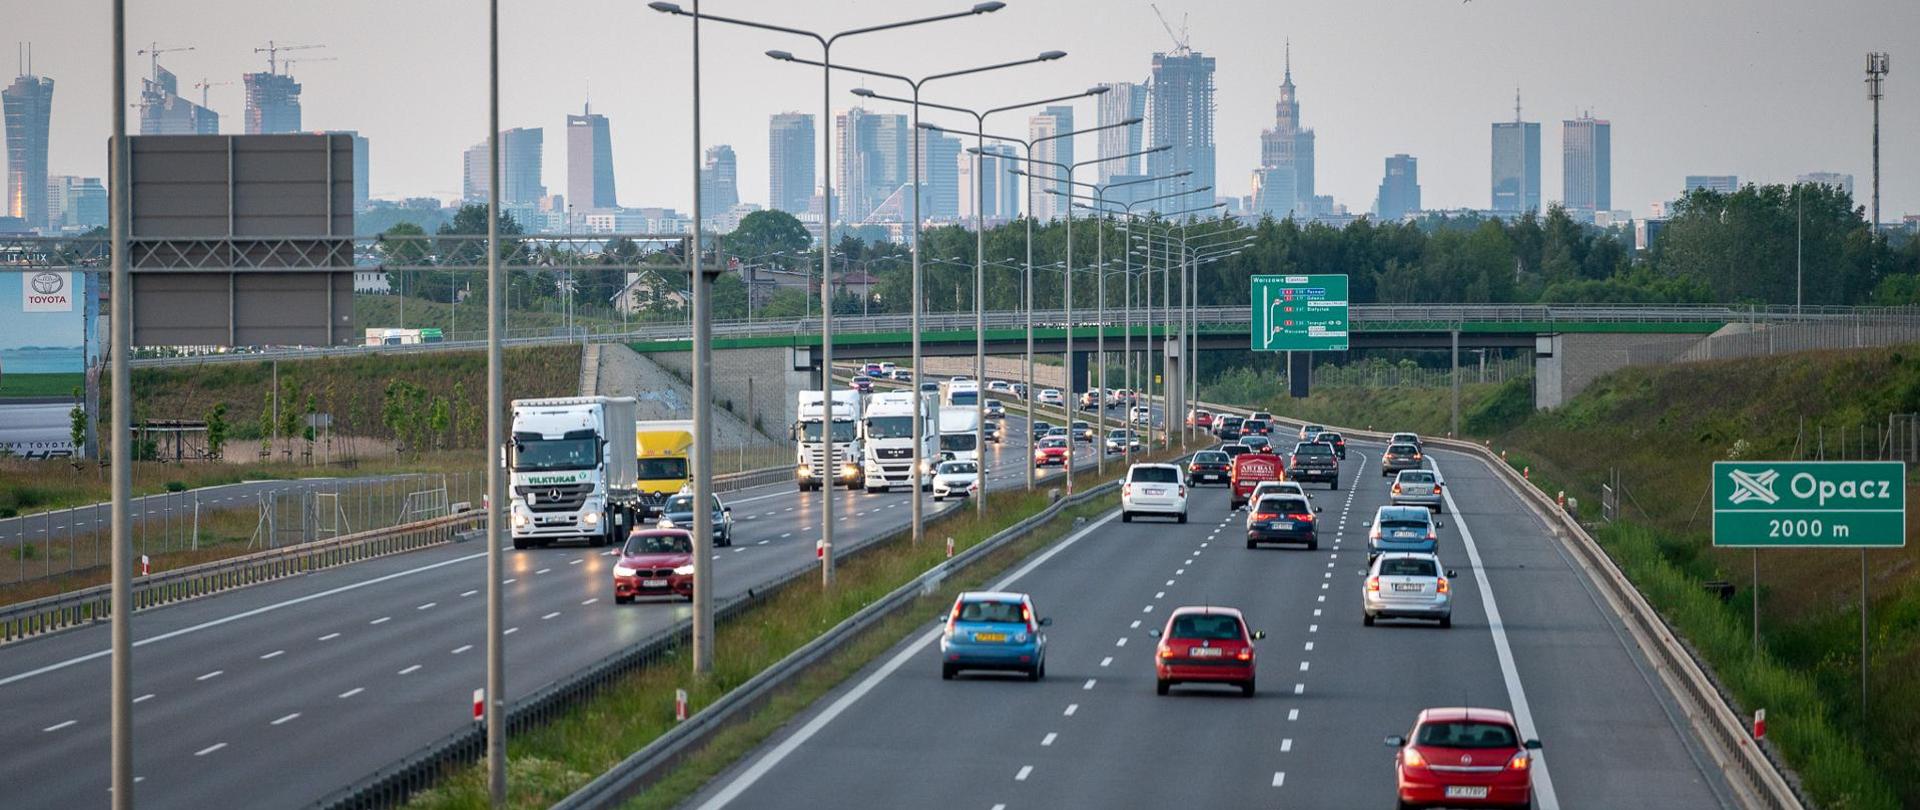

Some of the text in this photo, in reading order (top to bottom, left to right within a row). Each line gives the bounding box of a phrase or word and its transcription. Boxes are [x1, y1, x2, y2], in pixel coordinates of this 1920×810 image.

[29, 295, 66, 304] TOYOTA
[1790, 472, 1890, 506] Opacz
[1769, 519, 1849, 537] 2000 m
